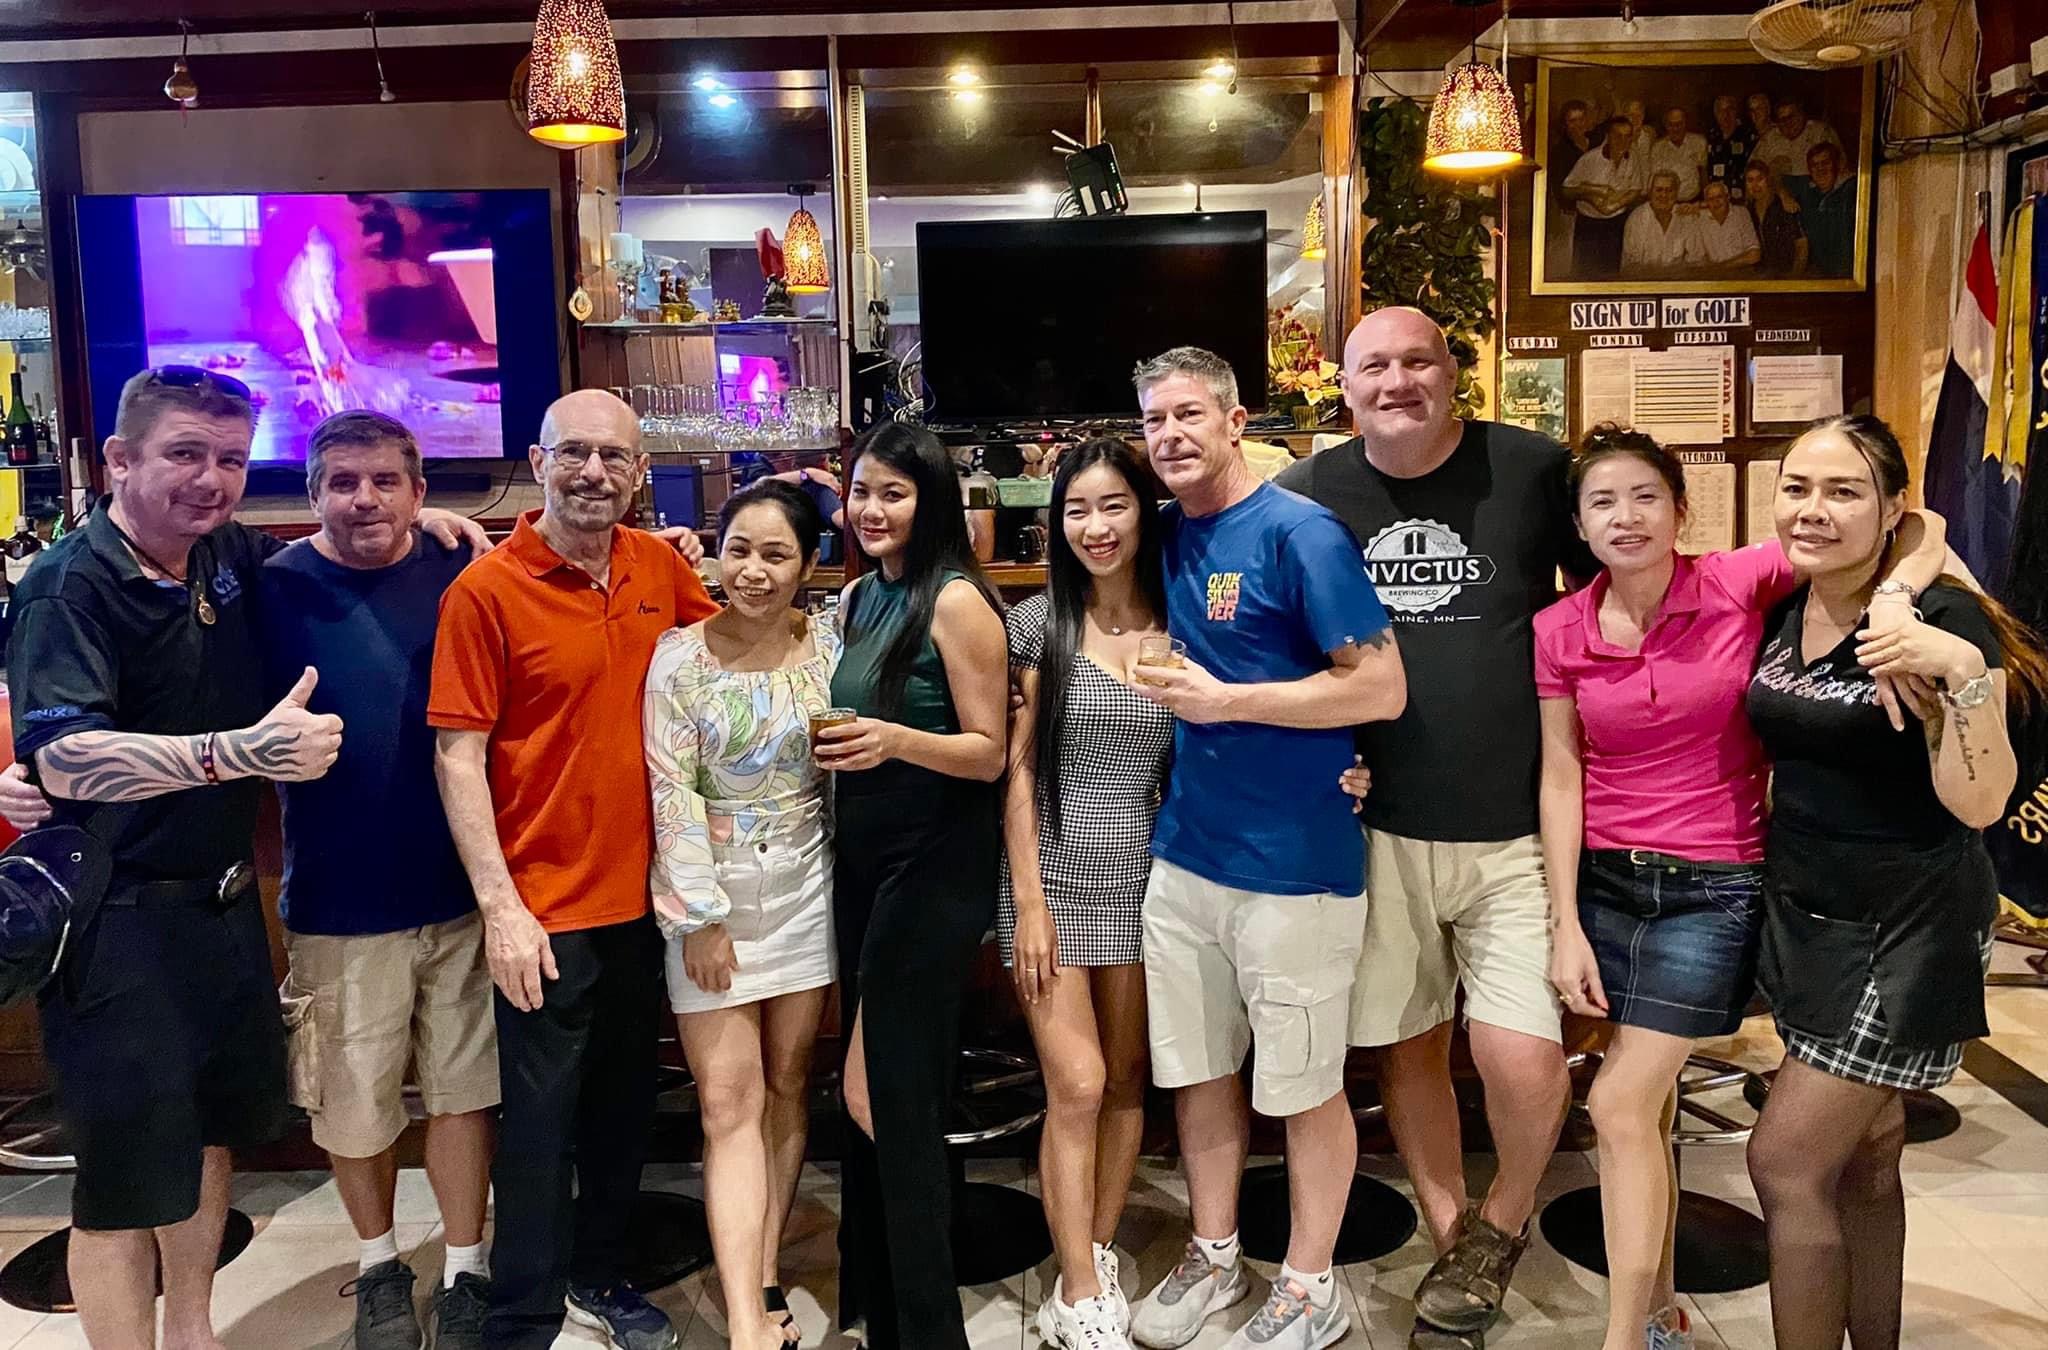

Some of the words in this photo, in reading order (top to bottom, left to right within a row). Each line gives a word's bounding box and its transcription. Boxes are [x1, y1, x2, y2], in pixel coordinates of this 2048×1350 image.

[1573, 303, 1622, 328] SIGN
[1629, 303, 1654, 326] UP
[1665, 305, 1689, 325] for
[1695, 299, 1745, 324] GOLF
[1591, 335, 1642, 346] MONDAY
[1675, 332, 1727, 343] TUESDAY
[1756, 330, 1809, 341] WEDNESDAY
[1509, 337, 1557, 349] SUNDAY
[1681, 452, 1725, 463] ATURDAY
[1363, 559, 1481, 583] NVICTUS
[1207, 572, 1244, 589] QUIK
[1388, 589, 1424, 597] BREWING
[1206, 603, 1236, 621] VER
[1388, 615, 1429, 624] AINE,
[1433, 615, 1455, 623] MN
